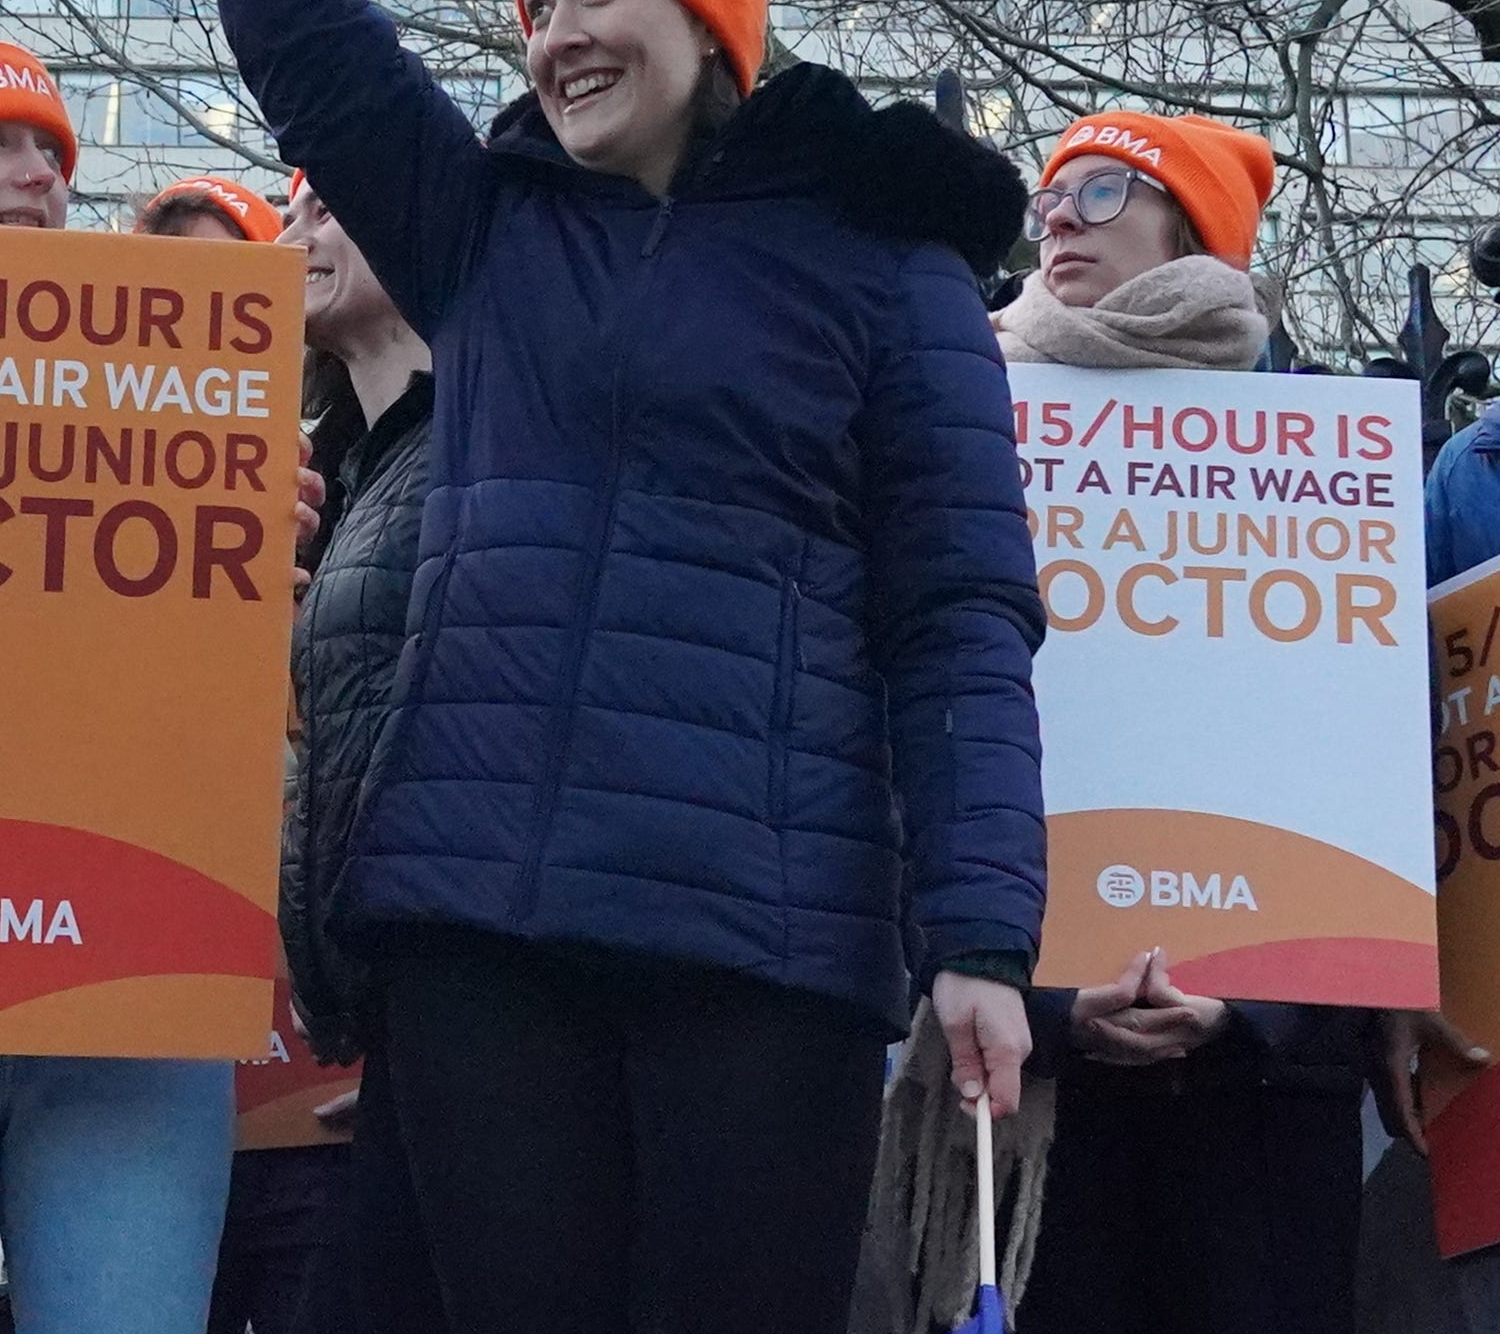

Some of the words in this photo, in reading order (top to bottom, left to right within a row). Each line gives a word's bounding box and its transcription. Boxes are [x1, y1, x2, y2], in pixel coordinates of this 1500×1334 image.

[1094, 127, 1161, 167] BMA
[209, 292, 272, 354] IS
[104, 363, 269, 417] WAGE
[1014, 399, 1315, 457] 15/HOUR
[1338, 415, 1392, 460] IS
[1076, 461, 1111, 494] A
[1128, 462, 1235, 500] FAIR
[1250, 468, 1394, 507] WAGE
[1102, 508, 1146, 551] A
[1159, 511, 1395, 563] JUNIOR
[1036, 560, 1398, 646] OCTOR
[1434, 730, 1499, 794] OR
[1149, 869, 1257, 912] BMA
